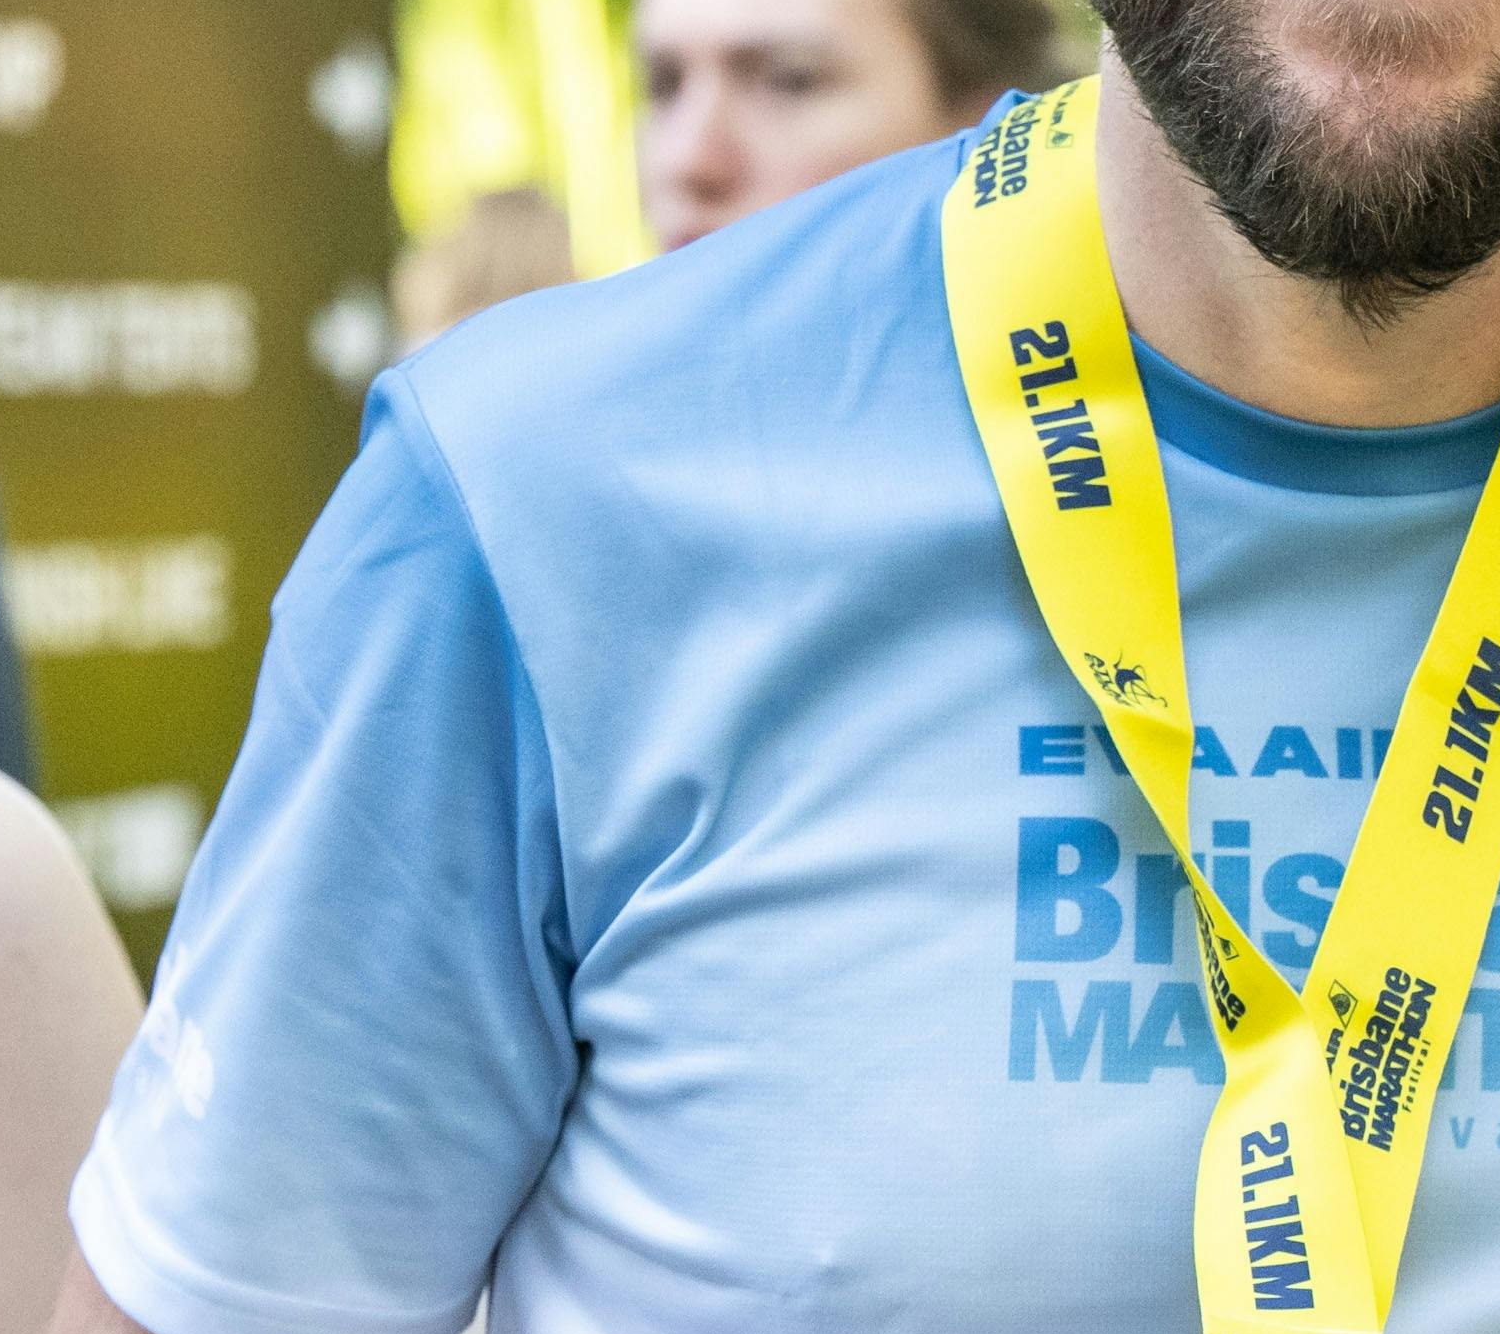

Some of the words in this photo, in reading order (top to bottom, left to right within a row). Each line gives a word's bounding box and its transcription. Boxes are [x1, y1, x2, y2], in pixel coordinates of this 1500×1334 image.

[1009, 320, 1112, 511] 21.1KM
[1367, 978, 1437, 1152] MARATHON
[1402, 1040, 1431, 1113] Festival
[1241, 1122, 1315, 1311] 21.1KM
